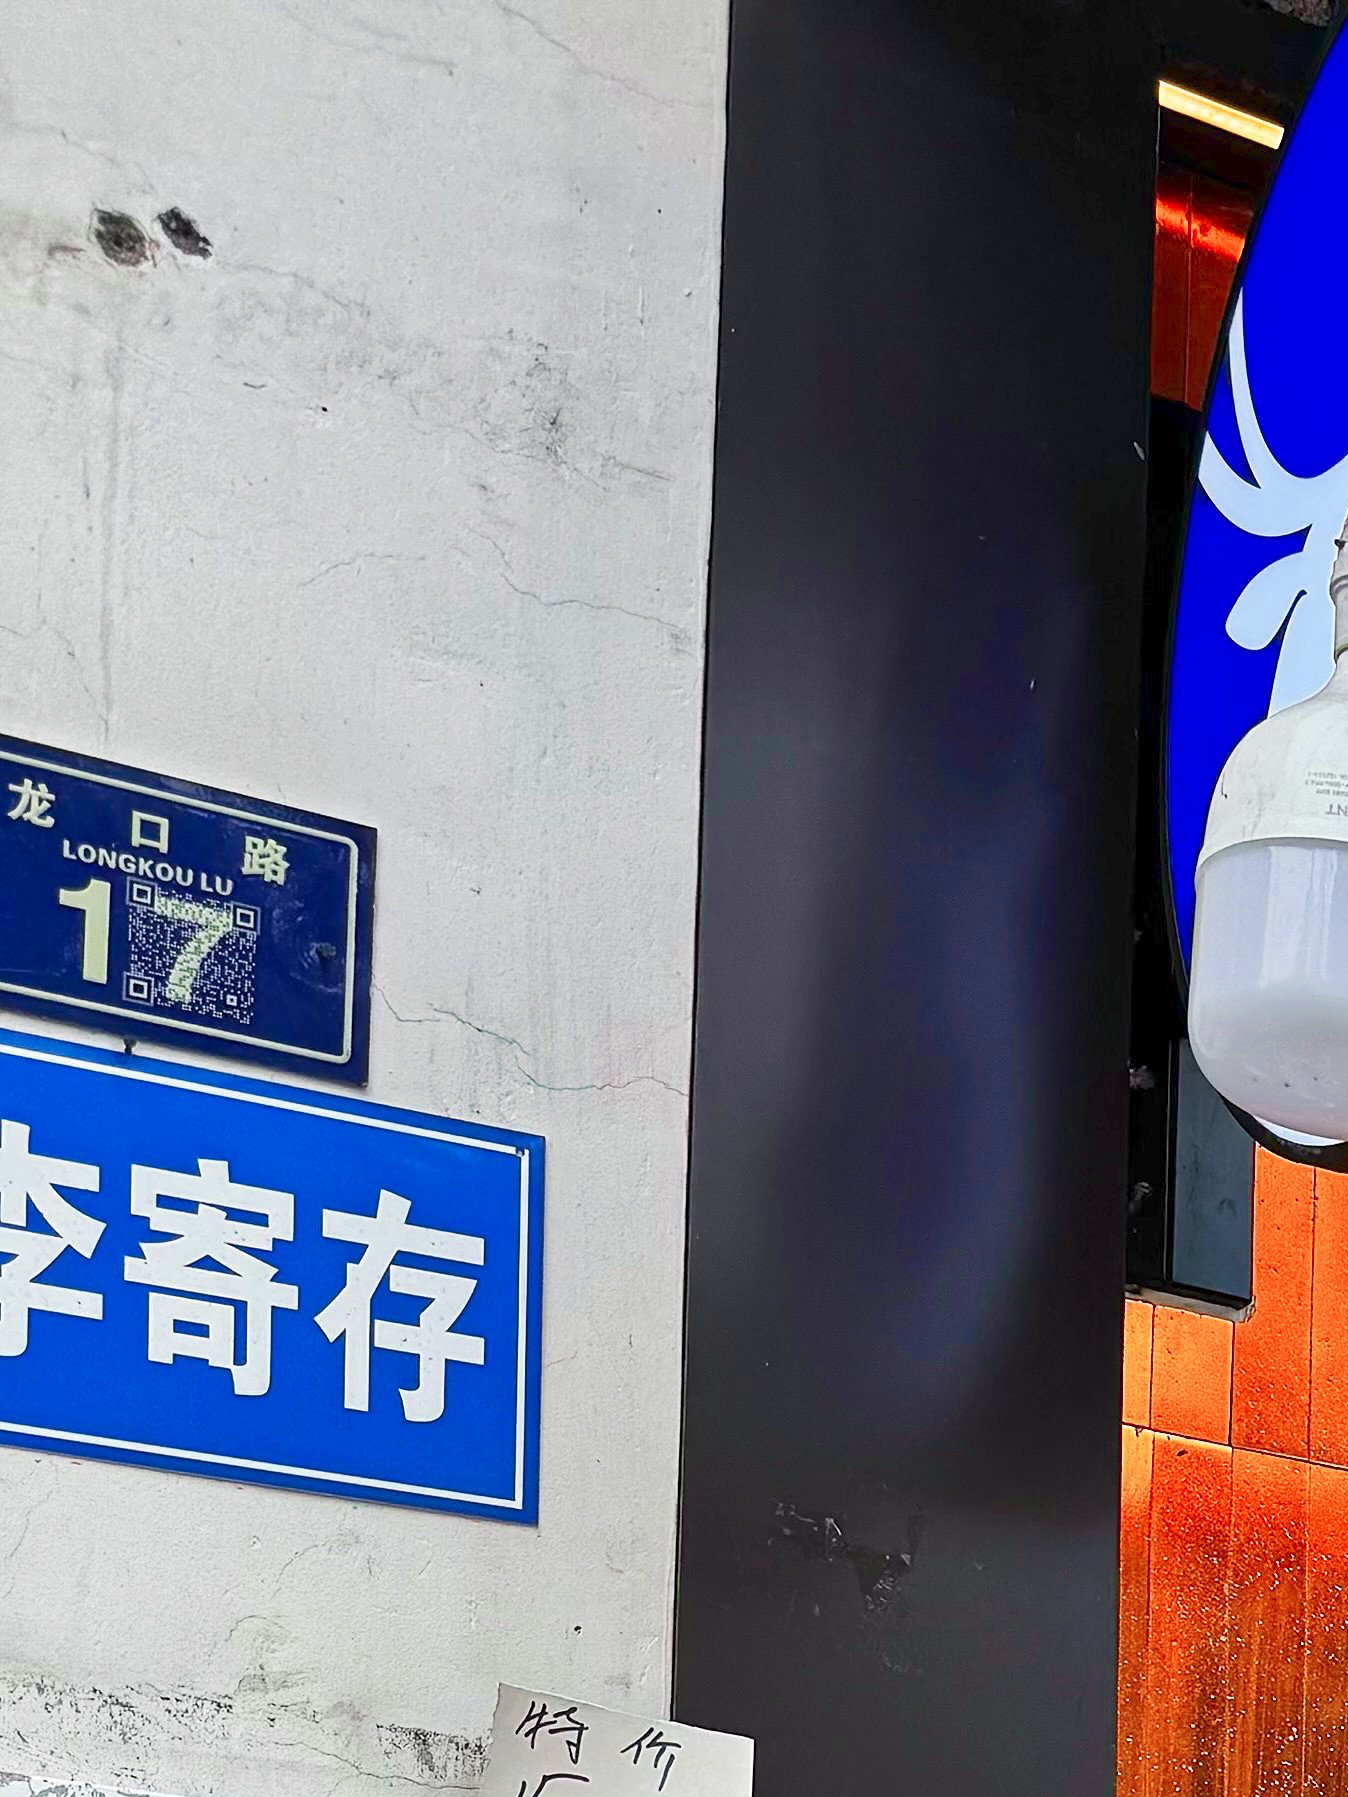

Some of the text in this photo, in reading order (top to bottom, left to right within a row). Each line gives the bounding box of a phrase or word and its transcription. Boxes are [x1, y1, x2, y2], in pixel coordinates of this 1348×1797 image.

[8, 776, 290, 888] 龙口路
[62, 837, 234, 898] LONGKOU LU
[58, 878, 234, 1004] 17
[515, 1700, 682, 1792] 特价
